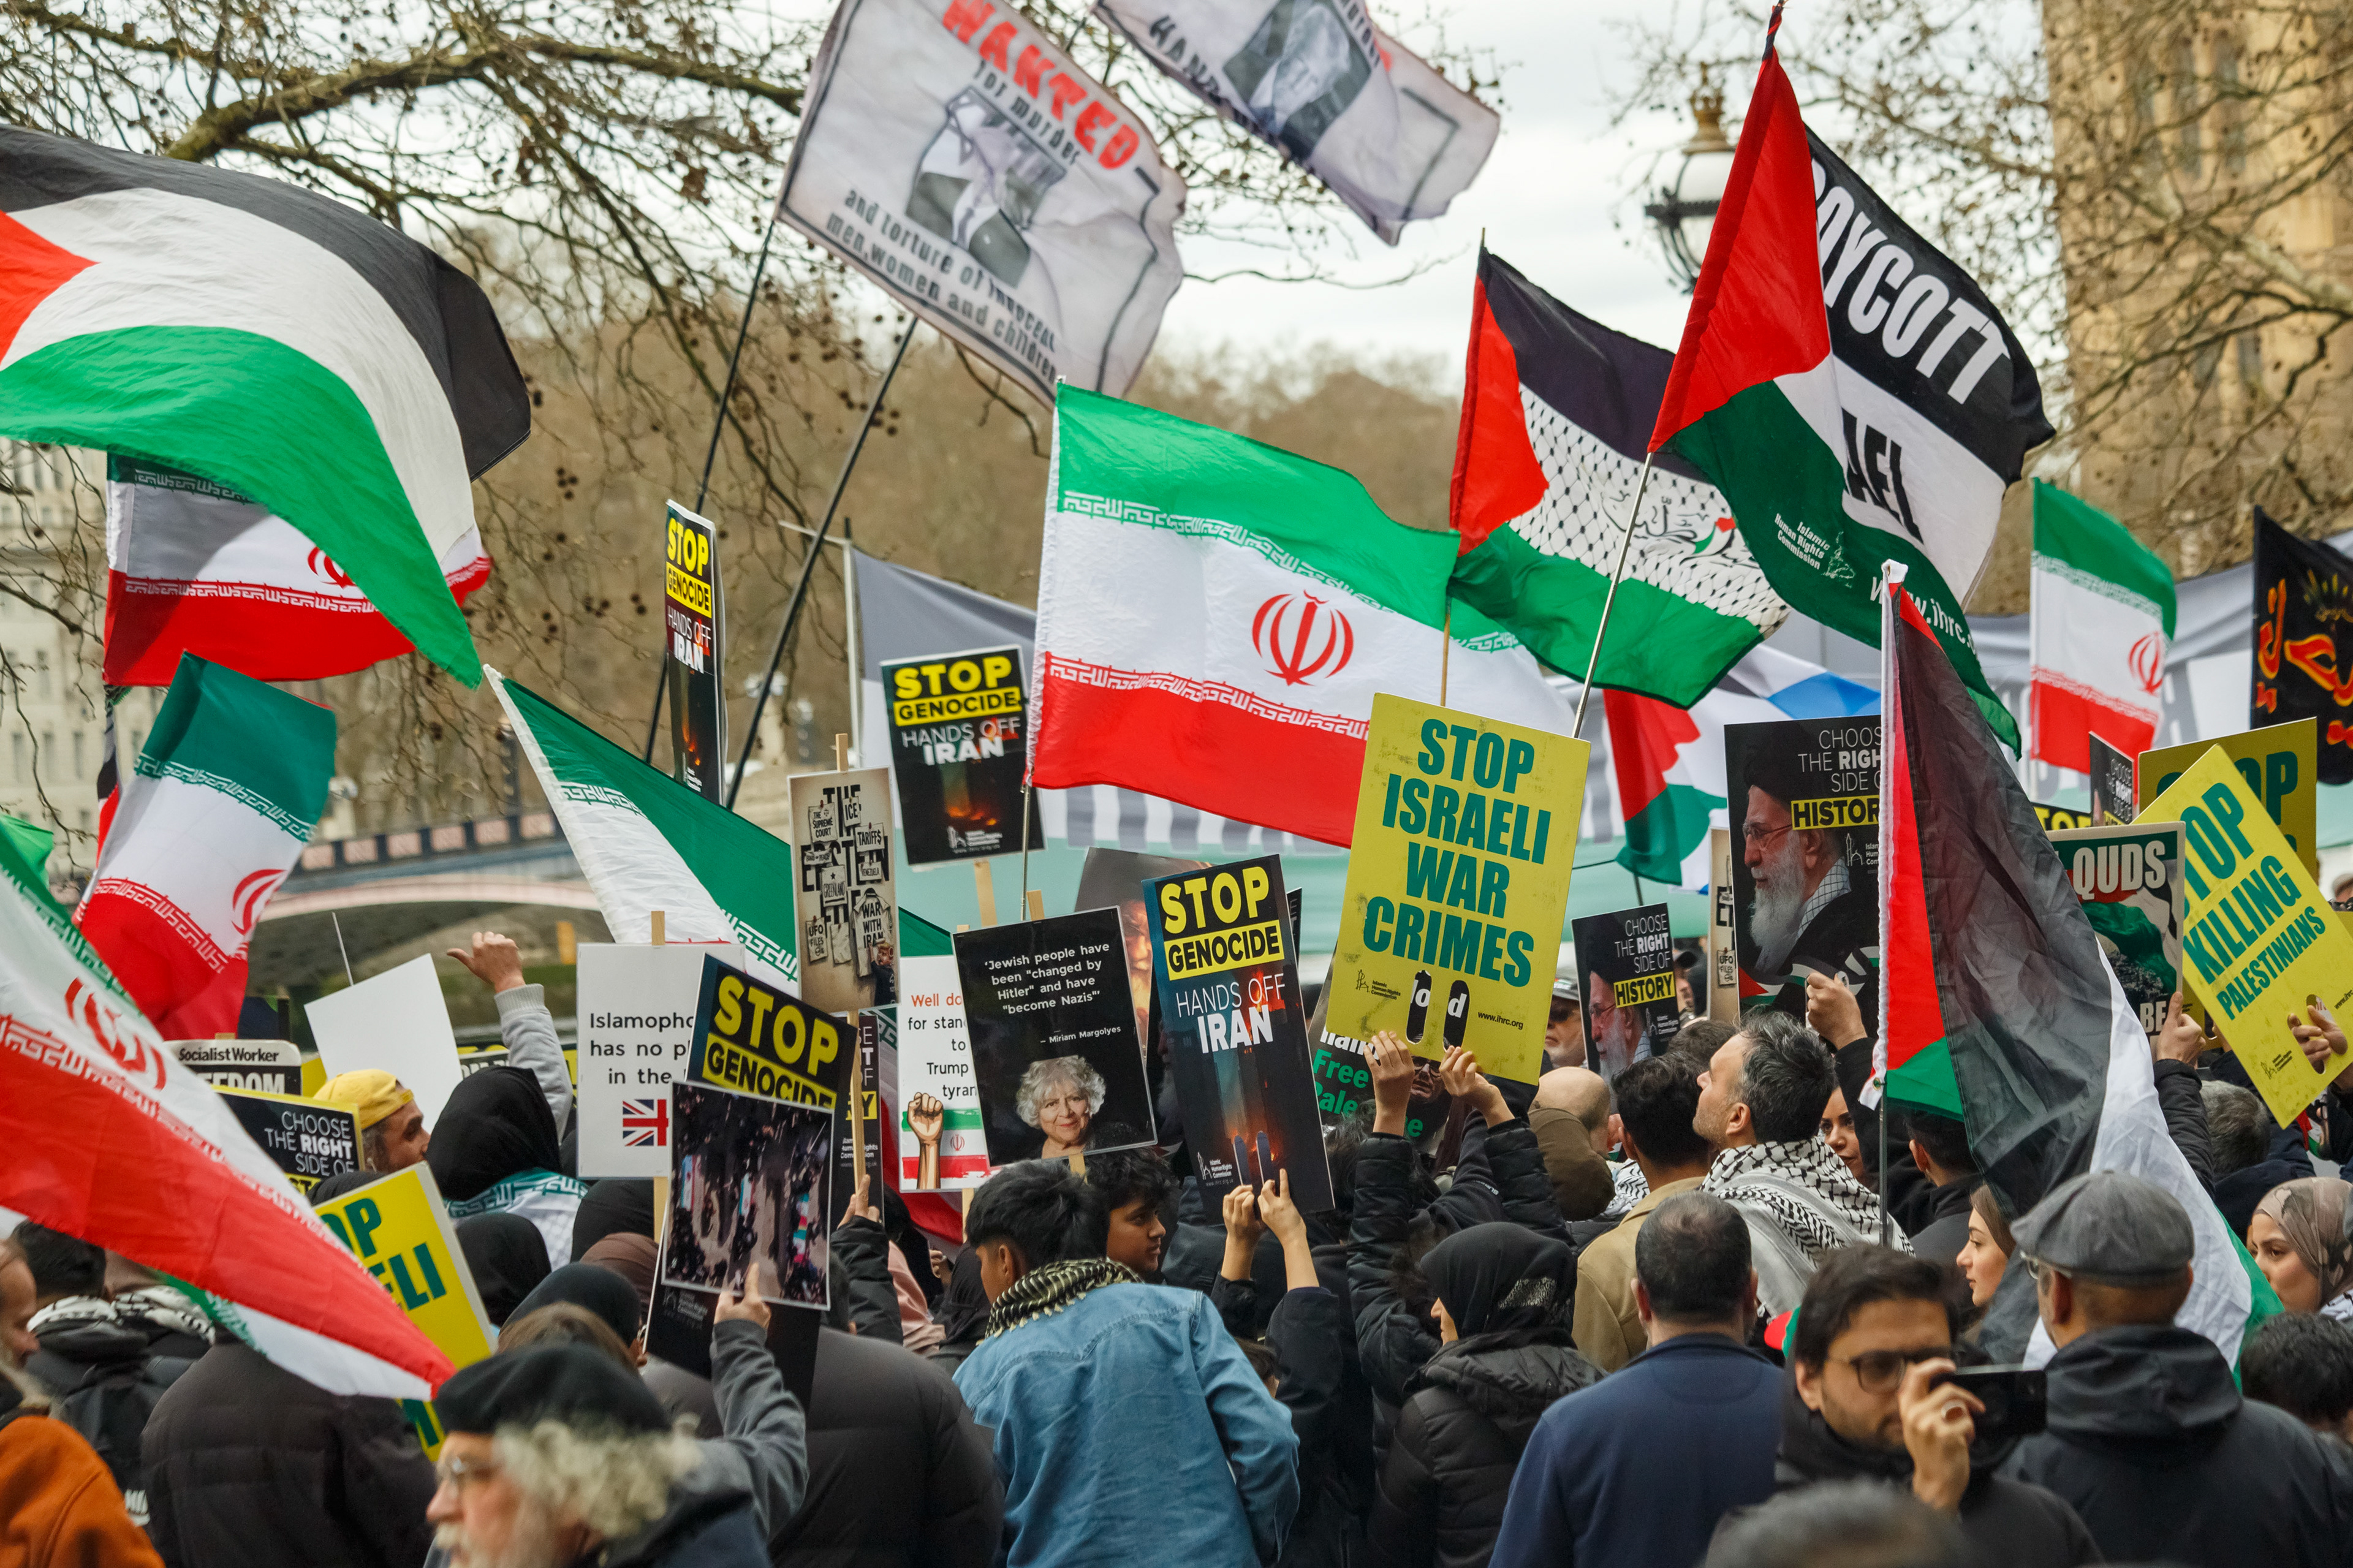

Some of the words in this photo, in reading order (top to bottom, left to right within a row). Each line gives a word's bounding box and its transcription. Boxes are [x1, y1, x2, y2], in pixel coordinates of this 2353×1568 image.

[1010, 95, 1080, 165] murder
[844, 189, 880, 223] and
[881, 212, 953, 275] torture
[960, 263, 984, 292] of
[949, 290, 988, 326] and
[667, 517, 709, 577] STOP
[1775, 513, 1797, 541] Human
[1797, 535, 1825, 559] Rights
[1778, 530, 1821, 570] Commission
[1797, 521, 1830, 551] Islamic
[668, 570, 710, 611] GENOCIDE
[667, 605, 693, 637] HANDS
[694, 618, 711, 649] OFF
[674, 631, 705, 673] IRAN
[894, 656, 1012, 699] STOP
[899, 691, 1018, 721] GENOCIDE
[901, 722, 975, 748] HANDS
[980, 716, 1021, 737] OFF
[1819, 726, 1881, 749] CHOOS
[923, 735, 1004, 766] IRAN
[1417, 718, 1534, 794] STOP
[1798, 752, 1833, 773] THE
[1838, 749, 1881, 770] RIGH
[1831, 771, 1869, 792] SIDE
[845, 803, 858, 820] ICE
[1382, 773, 1551, 865] ISRAELI
[1793, 797, 1879, 828] HISTOR
[816, 828, 832, 838] COURT
[862, 867, 879, 877] VENEZUELA
[1406, 841, 1510, 918] WAR
[2073, 840, 2166, 900] QUDS
[824, 881, 846, 898] GREENLAND
[1161, 865, 1269, 934] STOP
[862, 902, 881, 918] WAR
[2183, 855, 2302, 985] KILLING
[809, 925, 824, 936] UFO
[863, 918, 882, 933] WITH
[1625, 914, 1667, 937] CHOOSE
[810, 937, 824, 947] FILES
[1034, 948, 1075, 965] people
[1080, 943, 1110, 955] have
[1169, 925, 1280, 972] GENOCIDE
[1363, 896, 1534, 987] CRIMES
[1615, 940, 1635, 958] THE
[1637, 933, 1669, 954] RIGHT
[991, 972, 1022, 986] been
[1087, 960, 1102, 973] by
[1634, 954, 1656, 974] SIDE
[1658, 951, 1671, 971] OF
[2216, 906, 2326, 1021] PALESTINIANS
[911, 994, 939, 1007] Well
[946, 993, 963, 1006] do
[1040, 981, 1062, 993] and
[1066, 977, 1096, 990] have
[1176, 983, 1242, 1018] HANDS
[1248, 973, 1286, 1004] OFF
[1616, 975, 1674, 1006] HISTORY
[589, 1012, 694, 1032] Islamopho
[714, 975, 839, 1077] STOP
[908, 1017, 926, 1031] for
[1049, 1032, 1076, 1043] Miriam
[1079, 1026, 1121, 1039] Margolyes
[1197, 1004, 1273, 1054] IRAN
[1478, 1012, 1524, 1030] www.ihrc.org
[178, 1047, 231, 1061] Socialist
[232, 1048, 279, 1062] Worker
[590, 1040, 625, 1056] has
[637, 1043, 662, 1056] no
[952, 1039, 966, 1051] to
[608, 1069, 626, 1084] in
[638, 1068, 672, 1084] the
[707, 1042, 833, 1112] GENOCIDE
[926, 1062, 969, 1077] Trump
[1313, 1048, 1369, 1089] Free
[942, 1085, 977, 1100] tyran
[281, 1110, 351, 1140] CHOOSE
[264, 1128, 297, 1151] THE
[300, 1134, 353, 1160] RIGHT
[295, 1154, 330, 1176] SIDE
[333, 1161, 354, 1175] OF
